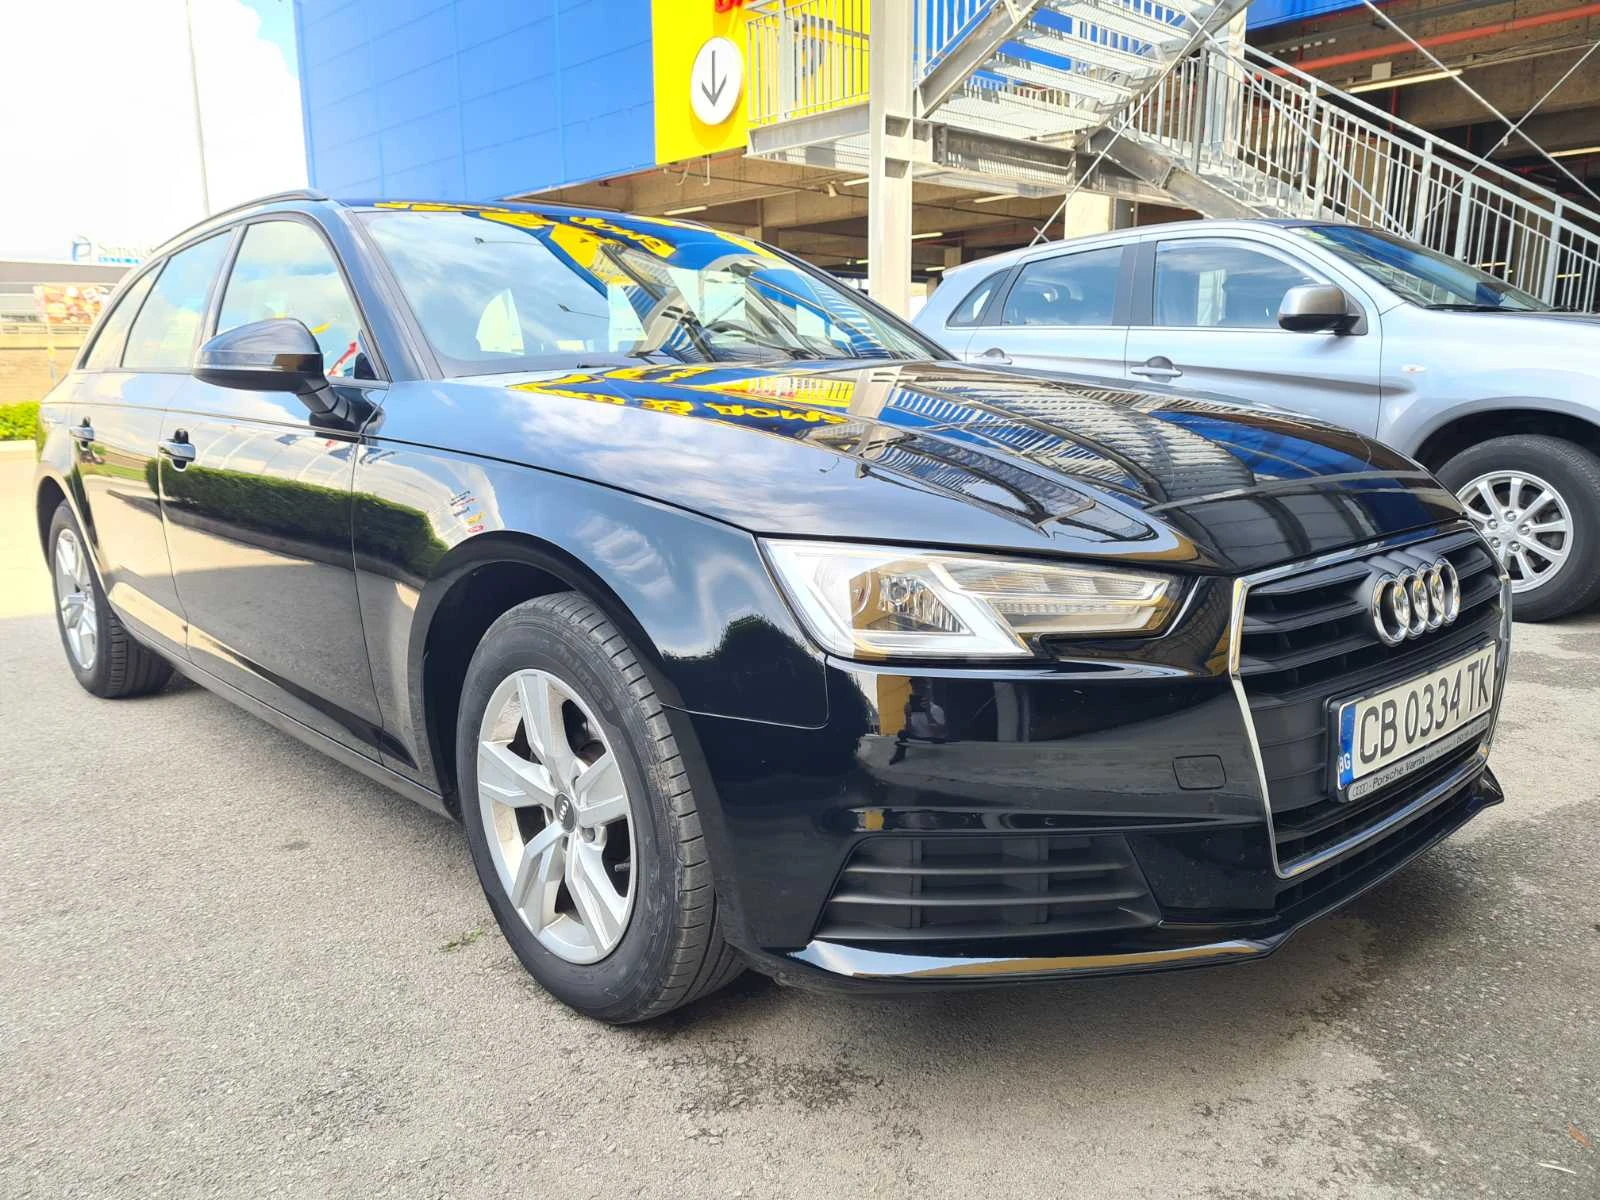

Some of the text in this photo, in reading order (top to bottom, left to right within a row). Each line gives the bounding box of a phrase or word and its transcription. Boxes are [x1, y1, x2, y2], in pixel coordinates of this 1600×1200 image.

[1360, 699, 1398, 764] CB
[1405, 669, 1461, 744] 0334
[1467, 654, 1491, 713] TK
[1373, 765, 1404, 789] Porsche
